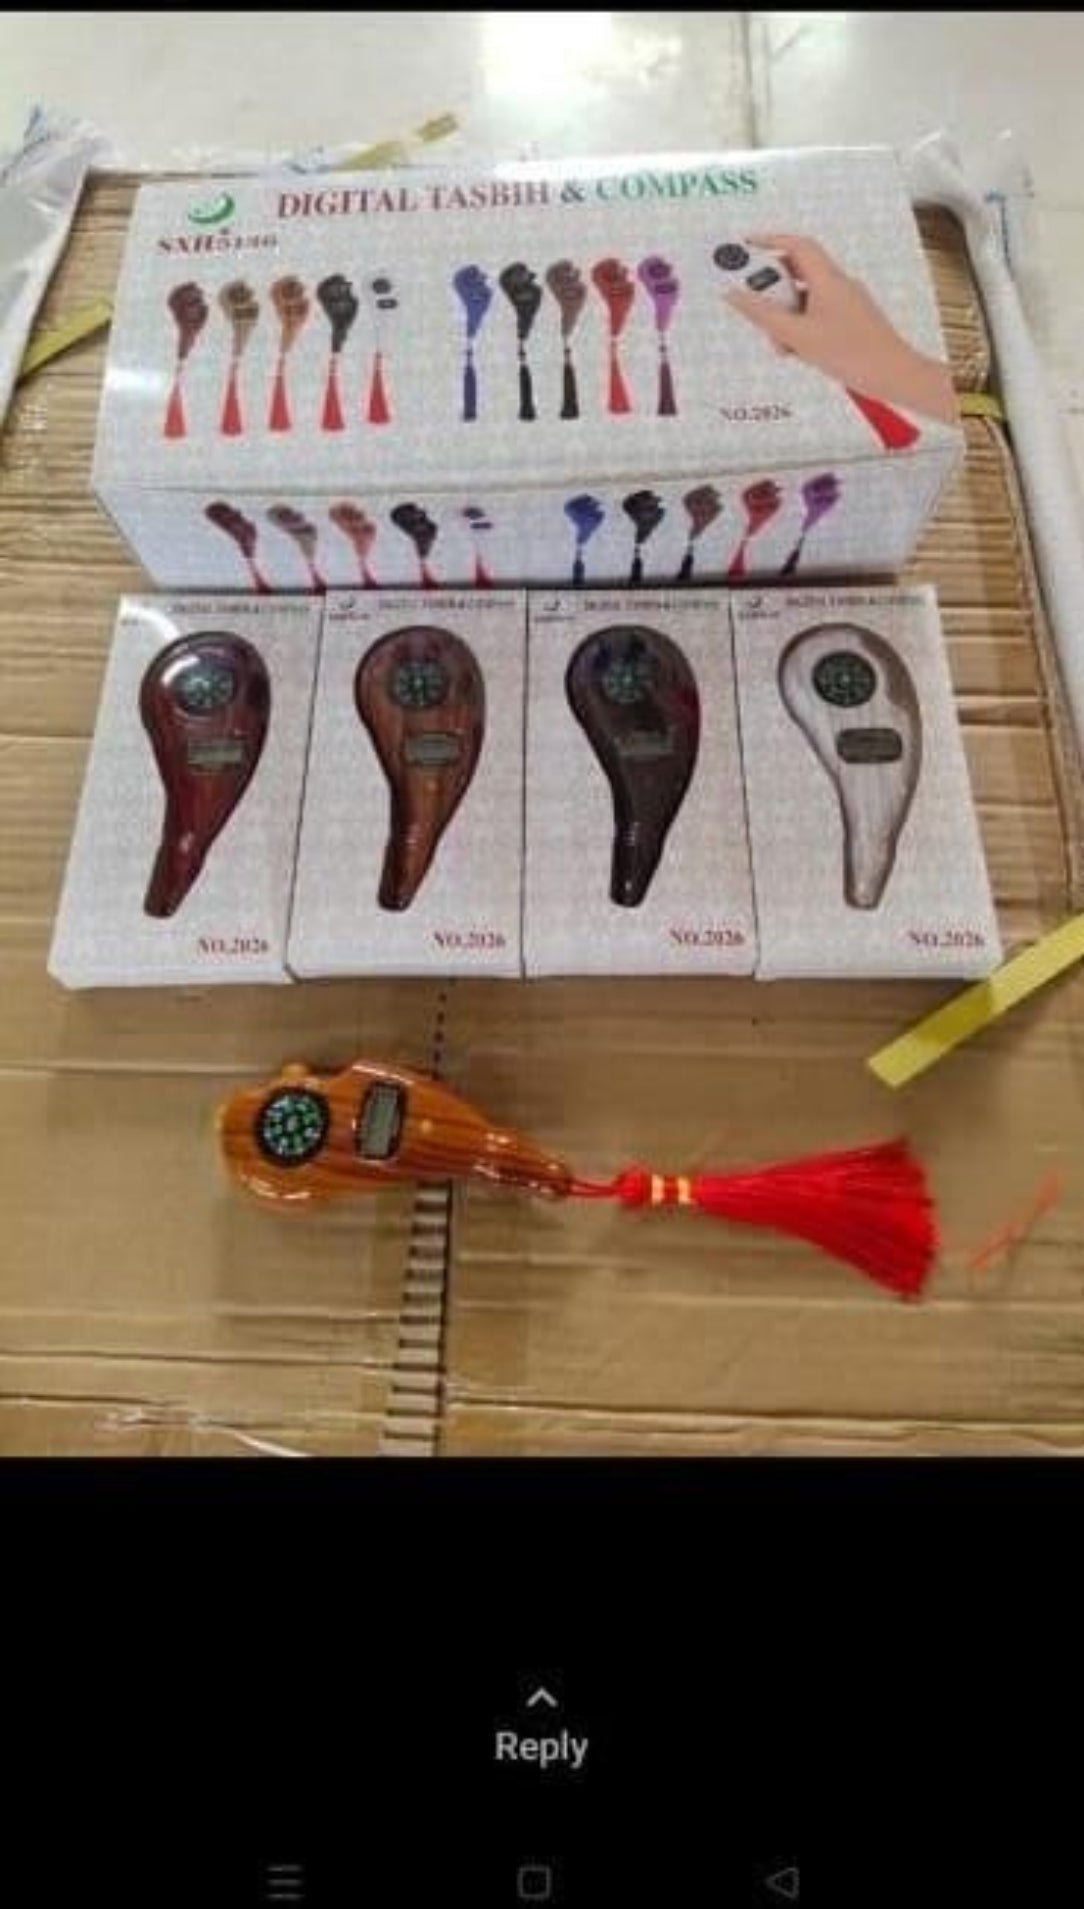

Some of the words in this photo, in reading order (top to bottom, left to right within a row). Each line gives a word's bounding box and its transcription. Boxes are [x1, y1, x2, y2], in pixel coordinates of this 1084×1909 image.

[278, 185, 418, 219] DIGITAL
[426, 180, 549, 211] TASBIH
[560, 179, 585, 203] &
[595, 168, 759, 202] COMPASS
[197, 936, 270, 955] NO.2026
[432, 930, 507, 949] NO.2026
[669, 928, 745, 947] NO.2026
[908, 928, 985, 948] NO.2026
